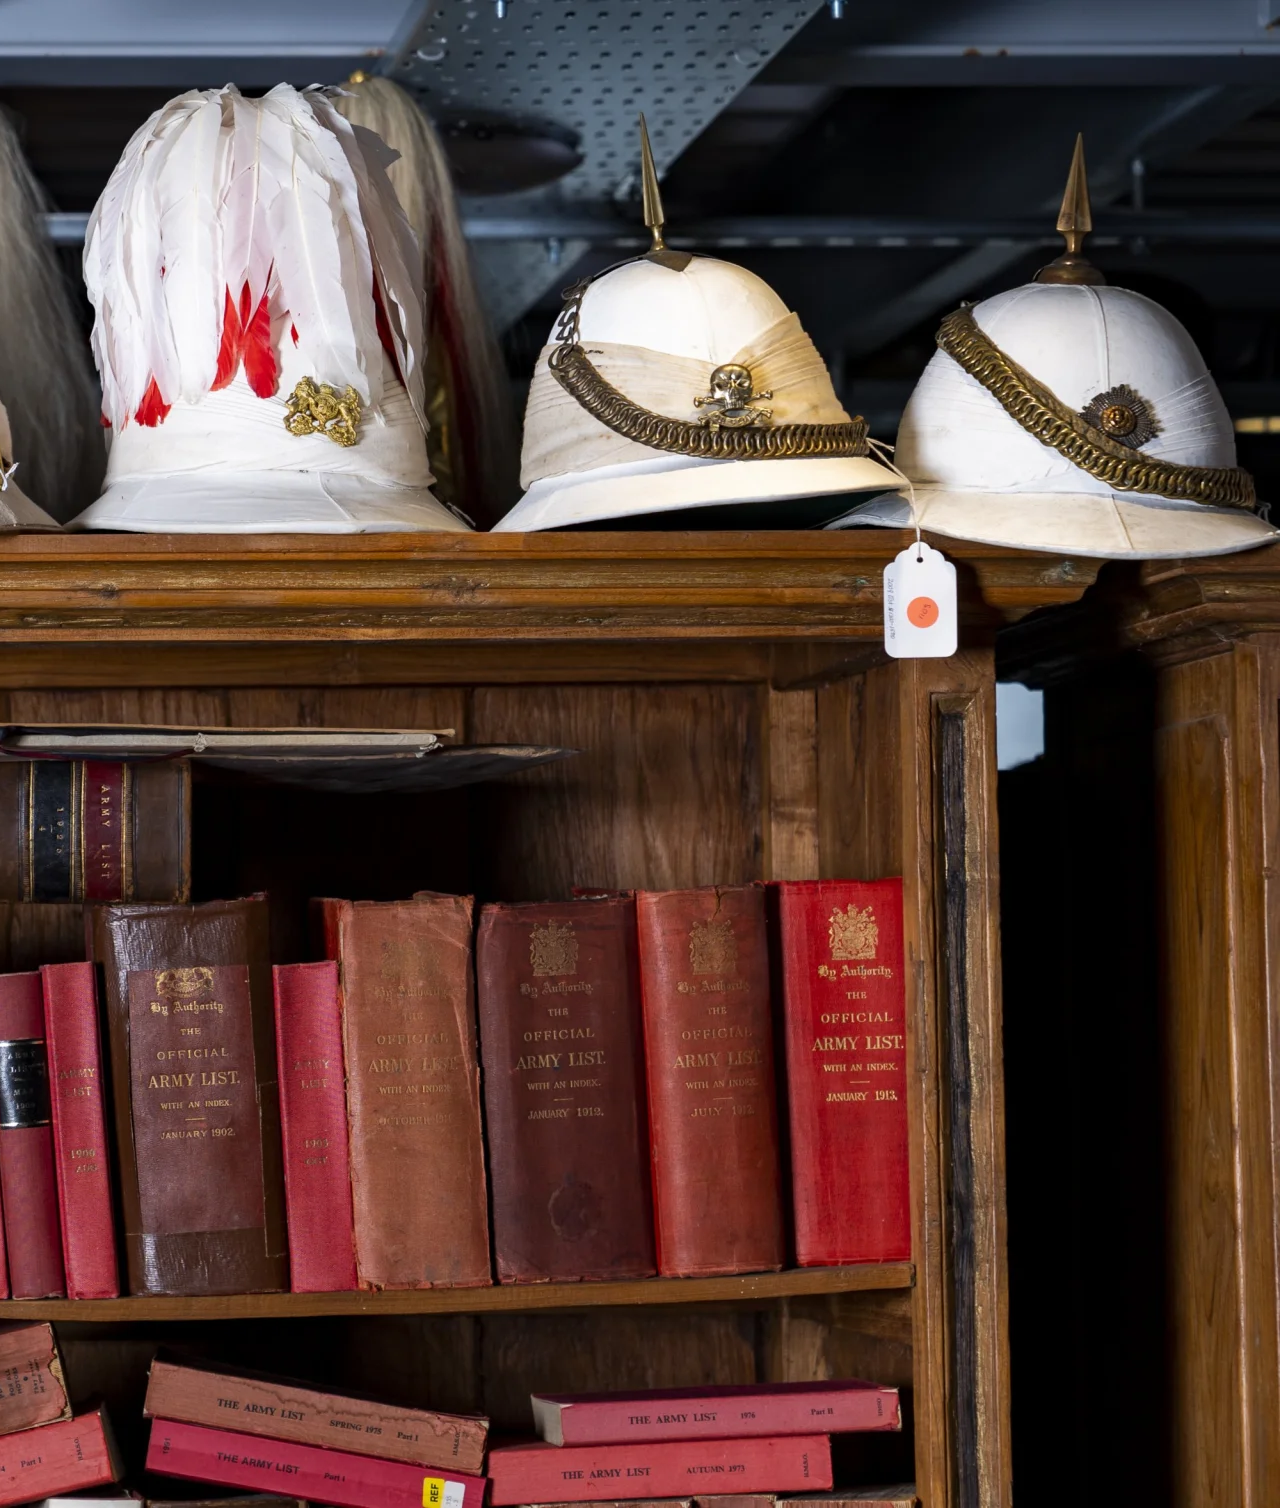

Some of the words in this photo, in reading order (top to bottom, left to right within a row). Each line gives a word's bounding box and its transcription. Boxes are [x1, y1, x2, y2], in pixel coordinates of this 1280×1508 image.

[101, 785, 111, 827] ARMY
[101, 844, 111, 879] LIST
[818, 964, 837, 981] By
[841, 964, 893, 979] Authority.
[520, 983, 538, 998] By
[150, 1001, 168, 1016] By
[173, 1000, 224, 1014] Authority
[548, 1008, 569, 1017] THE
[708, 1006, 727, 1015] THE
[820, 1012, 894, 1024] OFFICIAL
[180, 1028, 202, 1036] THE
[377, 1033, 448, 1045] OFFICIAL
[523, 1027, 596, 1042] OFFICIAL
[682, 1026, 752, 1041] OFFICIAL
[812, 1036, 861, 1051] ARMY
[865, 1035, 904, 1050] LIST.
[156, 1047, 230, 1061] OFFICIAL
[515, 1053, 563, 1070] ARMY
[568, 1050, 606, 1067] LIST.
[673, 1053, 721, 1069] ARMY
[368, 1059, 414, 1073] ARMY
[823, 1063, 846, 1072] WITH
[867, 1063, 898, 1071] INDEX.
[148, 1073, 195, 1089] ARMY
[200, 1070, 241, 1086] LIST.
[527, 1082, 550, 1091] WITH
[553, 1081, 566, 1089] AN
[570, 1079, 601, 1088] INDEX.
[686, 1081, 709, 1090] WITH
[712, 1080, 725, 1088] AN
[379, 1085, 402, 1095] WITH
[406, 1085, 418, 1093] AN
[826, 1092, 869, 1102] JANUARY
[160, 1102, 183, 1110] WITH
[205, 1099, 232, 1107] INDEX.
[527, 1107, 570, 1120] JANUARY
[577, 1107, 604, 1117] 1912.
[691, 1107, 723, 1118] JULY
[160, 1130, 208, 1140] JANUARY
[211, 1127, 236, 1137] 1902.
[217, 1398, 241, 1411] THE
[244, 1403, 277, 1416] ARMY
[281, 1410, 306, 1422] LIST
[329, 1419, 362, 1433] SPRING
[365, 1425, 382, 1436] 1975
[397, 1431, 413, 1441] Part
[628, 1415, 652, 1425] THE
[655, 1413, 689, 1424] ARMY
[693, 1412, 718, 1422] LIST
[740, 1411, 756, 1420] 1976
[810, 1408, 824, 1416] Part
[825, 1407, 834, 1415] II
[20, 1457, 37, 1469] Part
[217, 1452, 240, 1465] THE
[241, 1455, 274, 1470] ARMY
[275, 1462, 300, 1475] LIST
[324, 1472, 340, 1482] Part
[561, 1470, 585, 1481] THE
[588, 1468, 622, 1479] ARMY
[626, 1466, 651, 1477] LIST
[686, 1464, 725, 1475] AUTUMN
[728, 1464, 746, 1473] 1973
[429, 1483, 440, 1504] REF
